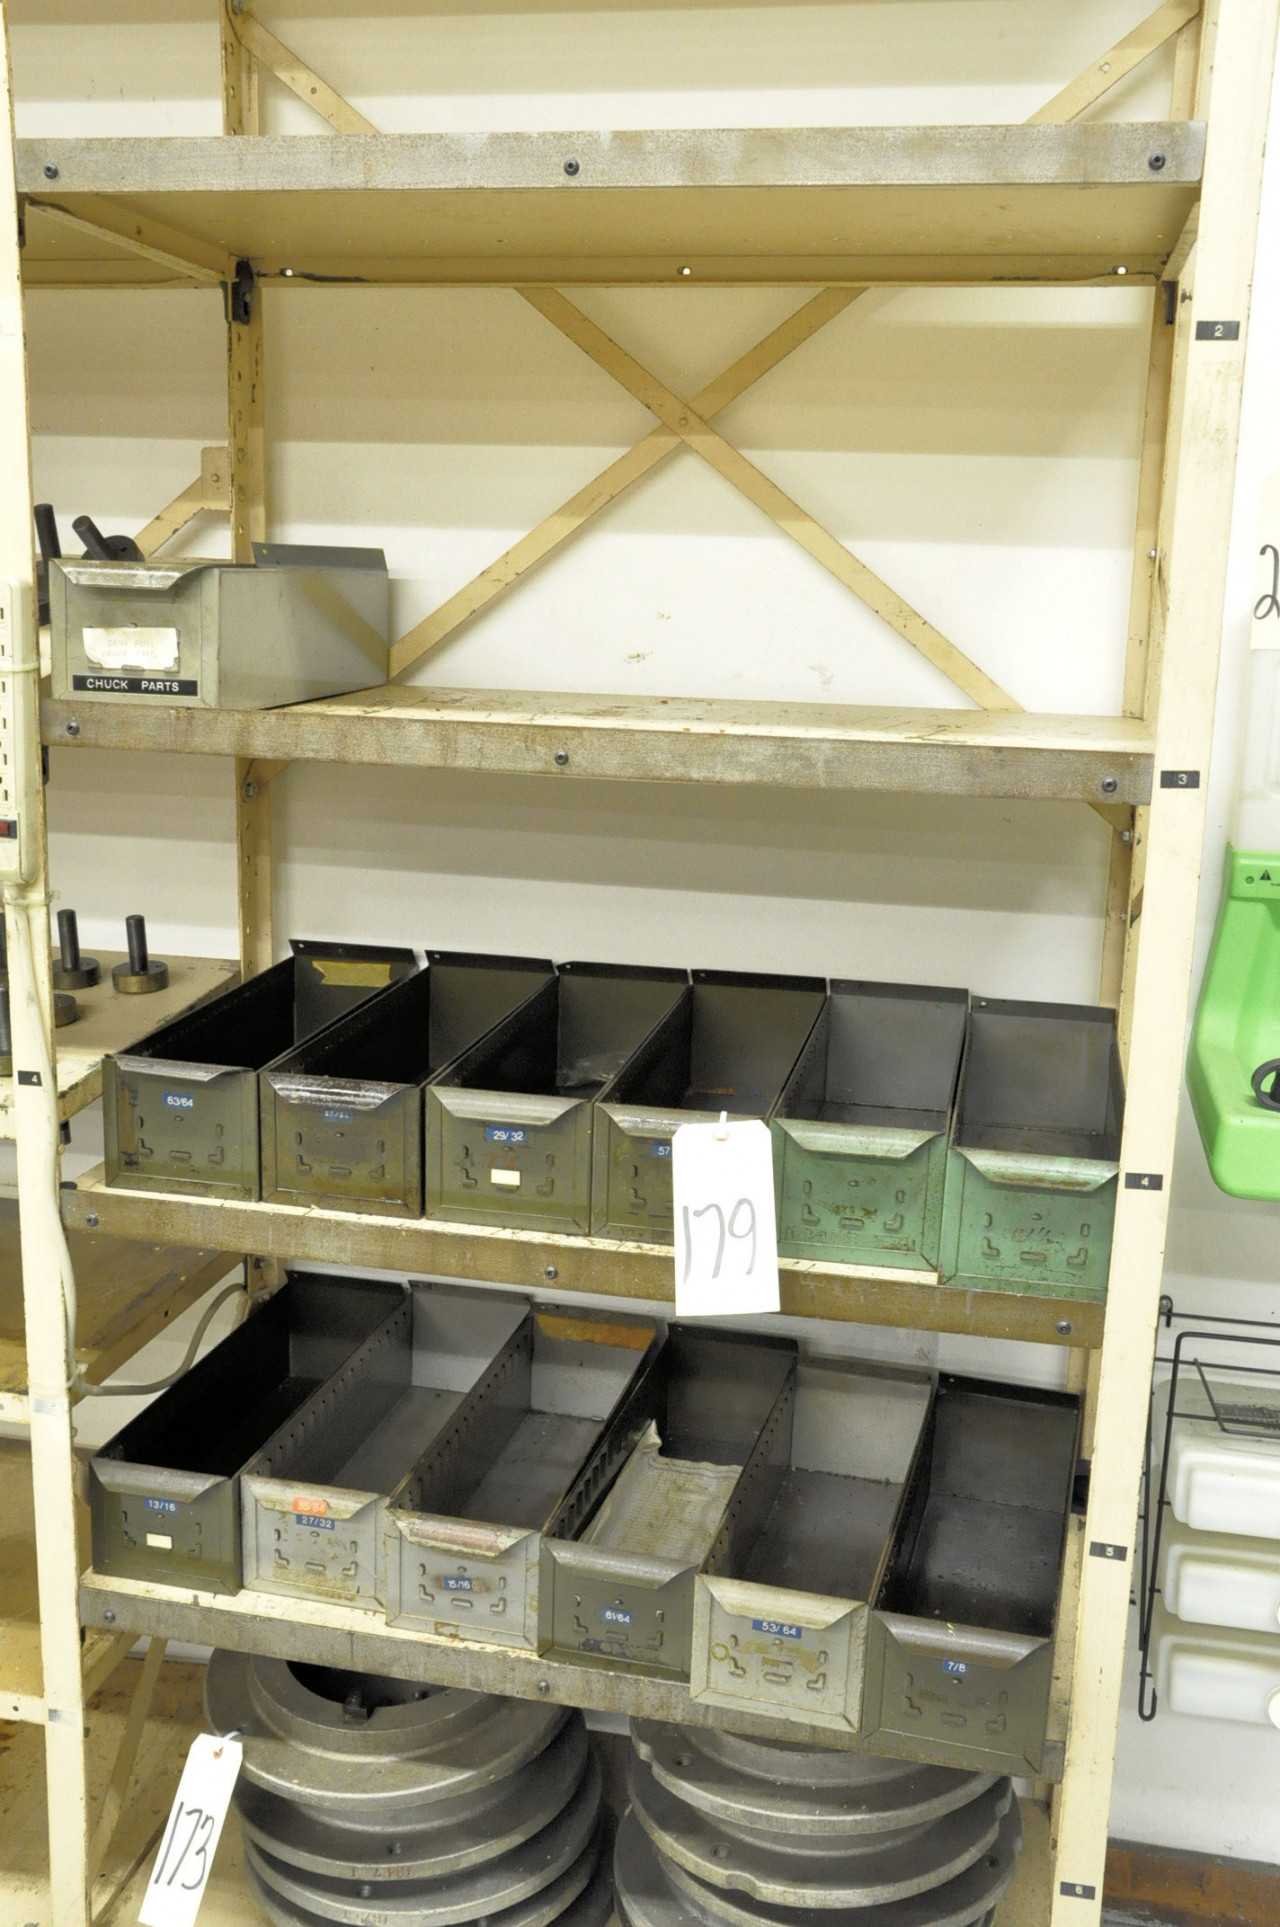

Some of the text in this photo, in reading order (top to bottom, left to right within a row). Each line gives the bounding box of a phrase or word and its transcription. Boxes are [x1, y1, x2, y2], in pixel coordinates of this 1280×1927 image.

[1214, 324, 1224, 337] 2
[86, 678, 180, 692] CHUCK PARTS
[1178, 773, 1188, 785] 3
[31, 1074, 38, 1083] 4
[1140, 1176, 1149, 1187] 4
[682, 1198, 756, 1285] 179
[148, 1499, 176, 1512] 13/16
[301, 1516, 332, 1529] 27/32
[1105, 1546, 1114, 1557] 5
[761, 1621, 797, 1636] 53/64
[947, 1661, 967, 1673] 7/8
[154, 1801, 215, 1890] 173
